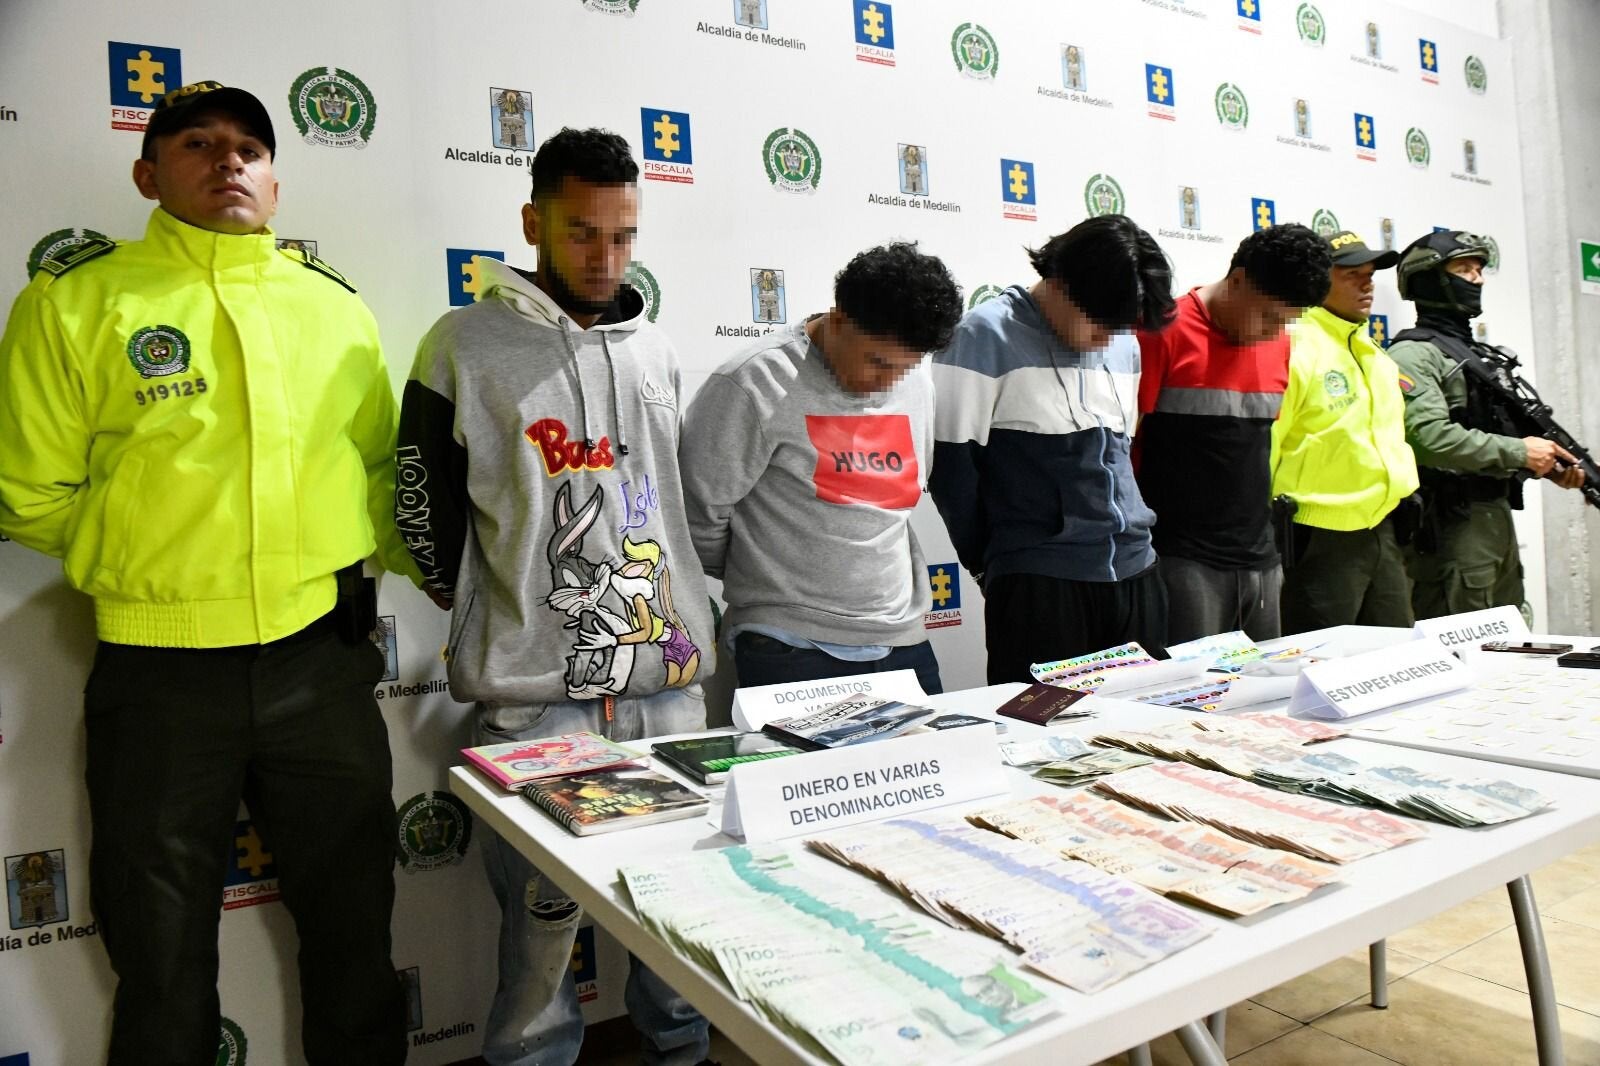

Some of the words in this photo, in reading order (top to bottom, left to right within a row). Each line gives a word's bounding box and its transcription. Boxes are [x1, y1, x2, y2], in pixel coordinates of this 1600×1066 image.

[696, 21, 742, 39] Alcaldía
[745, 31, 759, 42] de
[761, 33, 806, 51] Medellín
[856, 45, 895, 59] FISCALIA
[112, 108, 147, 120] FISC
[445, 147, 501, 165] Alcaldía
[506, 153, 523, 166] de
[645, 162, 693, 174] FISCALIA
[868, 193, 907, 207] Alcaldía
[909, 198, 921, 208] de
[923, 199, 961, 213] Medellín
[715, 325, 761, 338] Alcaldía
[135, 378, 207, 406] 919125
[831, 451, 903, 473] HUGO
[396, 445, 435, 567] LOONEY
[617, 473, 658, 534] Lola
[924, 610, 962, 621] FISCALIA
[1438, 620, 1509, 647] CELULARES
[774, 681, 873, 704] DOCUMENTOS
[1326, 660, 1453, 703] ESTUPEFACIENTES
[782, 775, 849, 801] DINERO
[853, 770, 877, 788] EN
[880, 759, 941, 783] VARIAS
[790, 783, 945, 825] DENOMINACIONES
[223, 882, 277, 899] FISCAL
[28, 931, 52, 946] de
[744, 949, 775, 961] 100
[413, 1020, 474, 1047] Medellín
